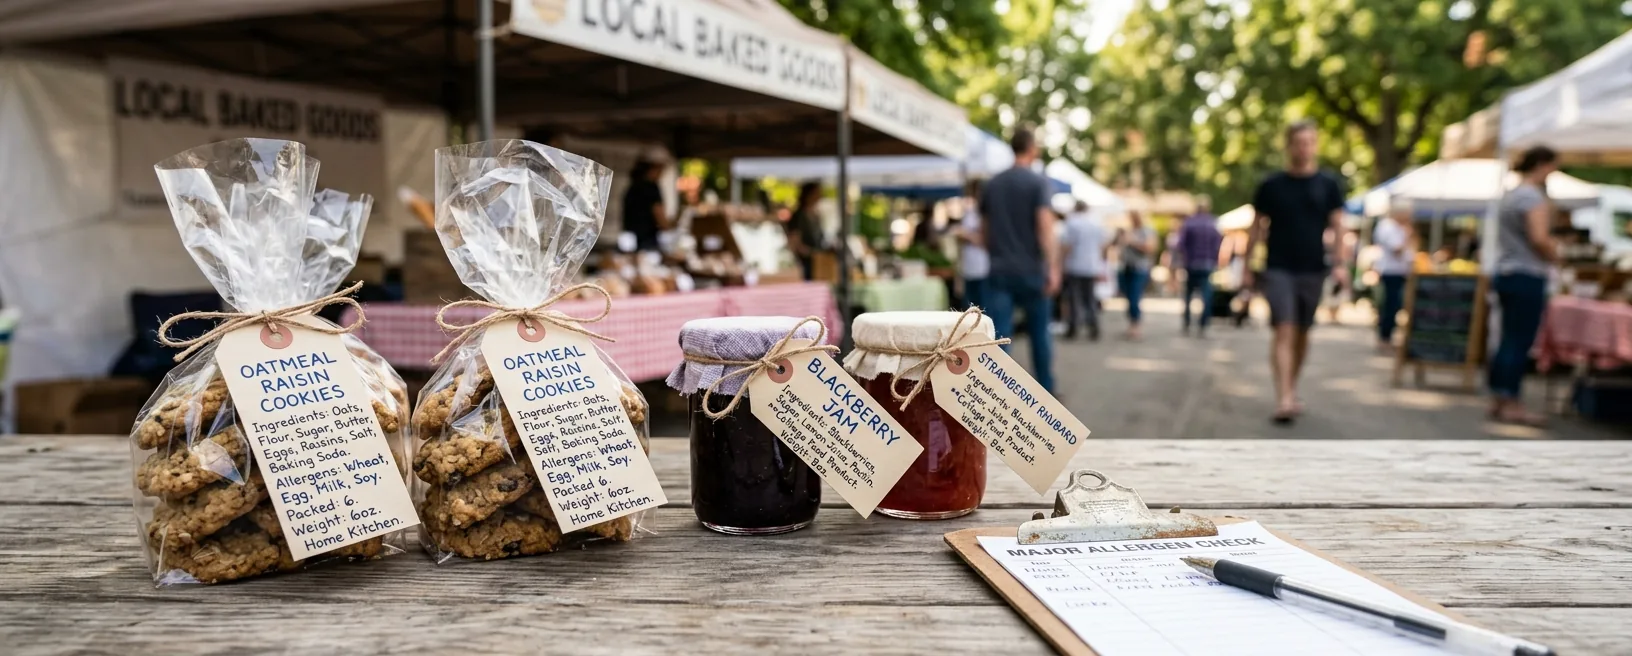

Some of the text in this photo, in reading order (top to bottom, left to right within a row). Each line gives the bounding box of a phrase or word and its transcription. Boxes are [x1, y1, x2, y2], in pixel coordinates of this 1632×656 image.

[695, 16, 769, 75] BAKED
[114, 76, 209, 126] LOCAL
[217, 90, 298, 132] BAKED
[240, 351, 336, 378] OATMEAL
[504, 346, 585, 370] OATMEAL
[261, 369, 330, 394] RAISIN
[522, 362, 581, 384] RAISIN
[978, 353, 1038, 408] STRAWBERRY
[260, 385, 345, 412] COOKIES
[524, 376, 594, 401] COOKIES
[807, 358, 900, 445] BLACKBERRY
[252, 404, 363, 434] Ingredients: Oats,
[523, 419, 554, 431] Flour,
[822, 398, 858, 434] JAM
[258, 415, 373, 446] Flour, Sugar, Butter,
[301, 436, 348, 451] Raisins,
[349, 427, 377, 440] Salt,
[599, 429, 626, 440] Soda.
[269, 448, 350, 473] Baking Soda.
[599, 439, 636, 456] Wheat,
[276, 453, 389, 489] Allergens: Wheat,
[577, 461, 606, 475] Milk,
[608, 456, 631, 467] Soy.
[281, 472, 382, 505] Egg, Milk, Soy.
[559, 492, 603, 512] Weight:
[287, 495, 358, 521] Packed: 6.
[292, 506, 381, 536] Weight: 6oz.
[570, 496, 654, 525] Home Kitchen.
[305, 516, 403, 551] Home Kitchen.
[1006, 538, 1266, 558] MAJOR ALLERGEN CHECK
